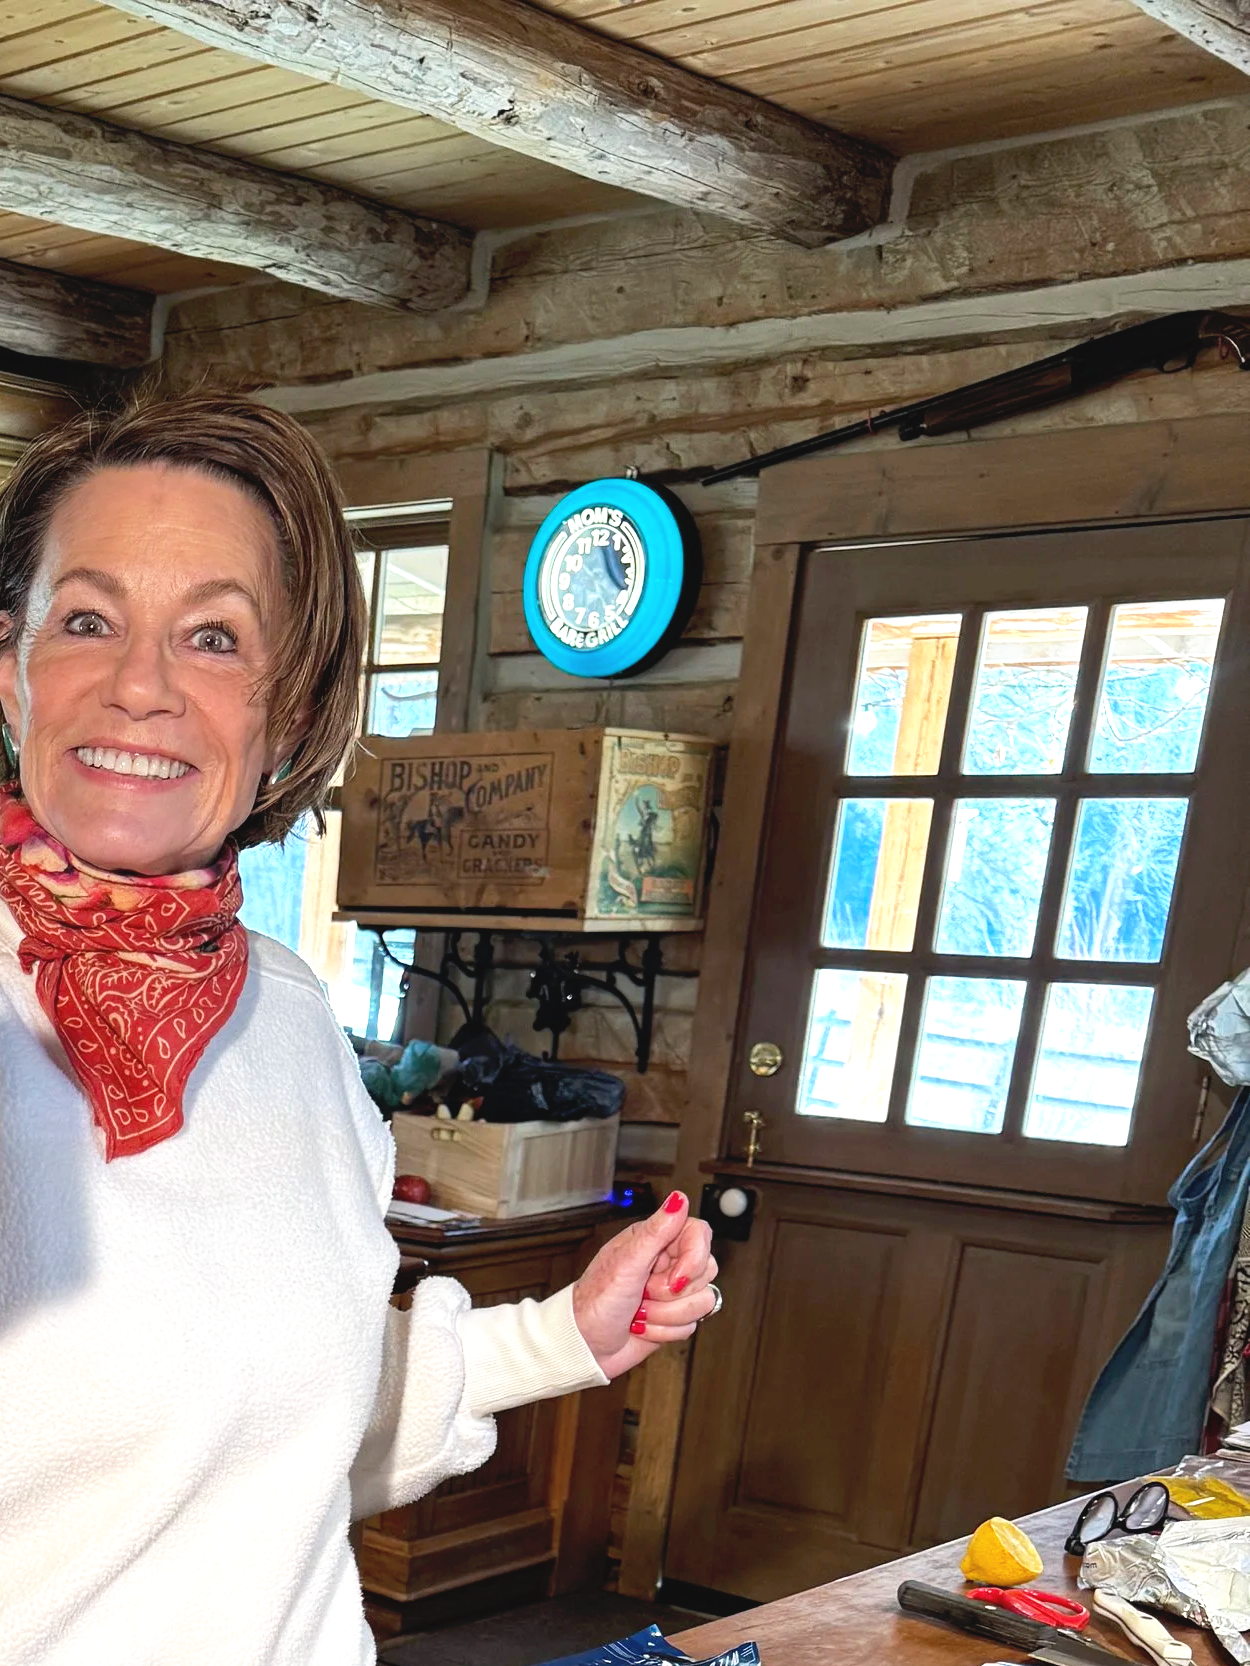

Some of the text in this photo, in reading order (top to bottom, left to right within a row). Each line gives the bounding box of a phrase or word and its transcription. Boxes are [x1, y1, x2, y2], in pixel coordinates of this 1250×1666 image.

[568, 507, 624, 534] MOM'S
[576, 537, 592, 554] 11
[591, 529, 610, 547] 12
[565, 554, 583, 572] 10
[559, 572, 571, 590] 9
[562, 593, 575, 611] 8
[575, 607, 587, 625] 7
[588, 611, 600, 629] 6
[604, 604, 616, 622] 5
[390, 761, 472, 792] BISHOP
[465, 764, 548, 815] COMPANY
[468, 834, 540, 849] CANDY
